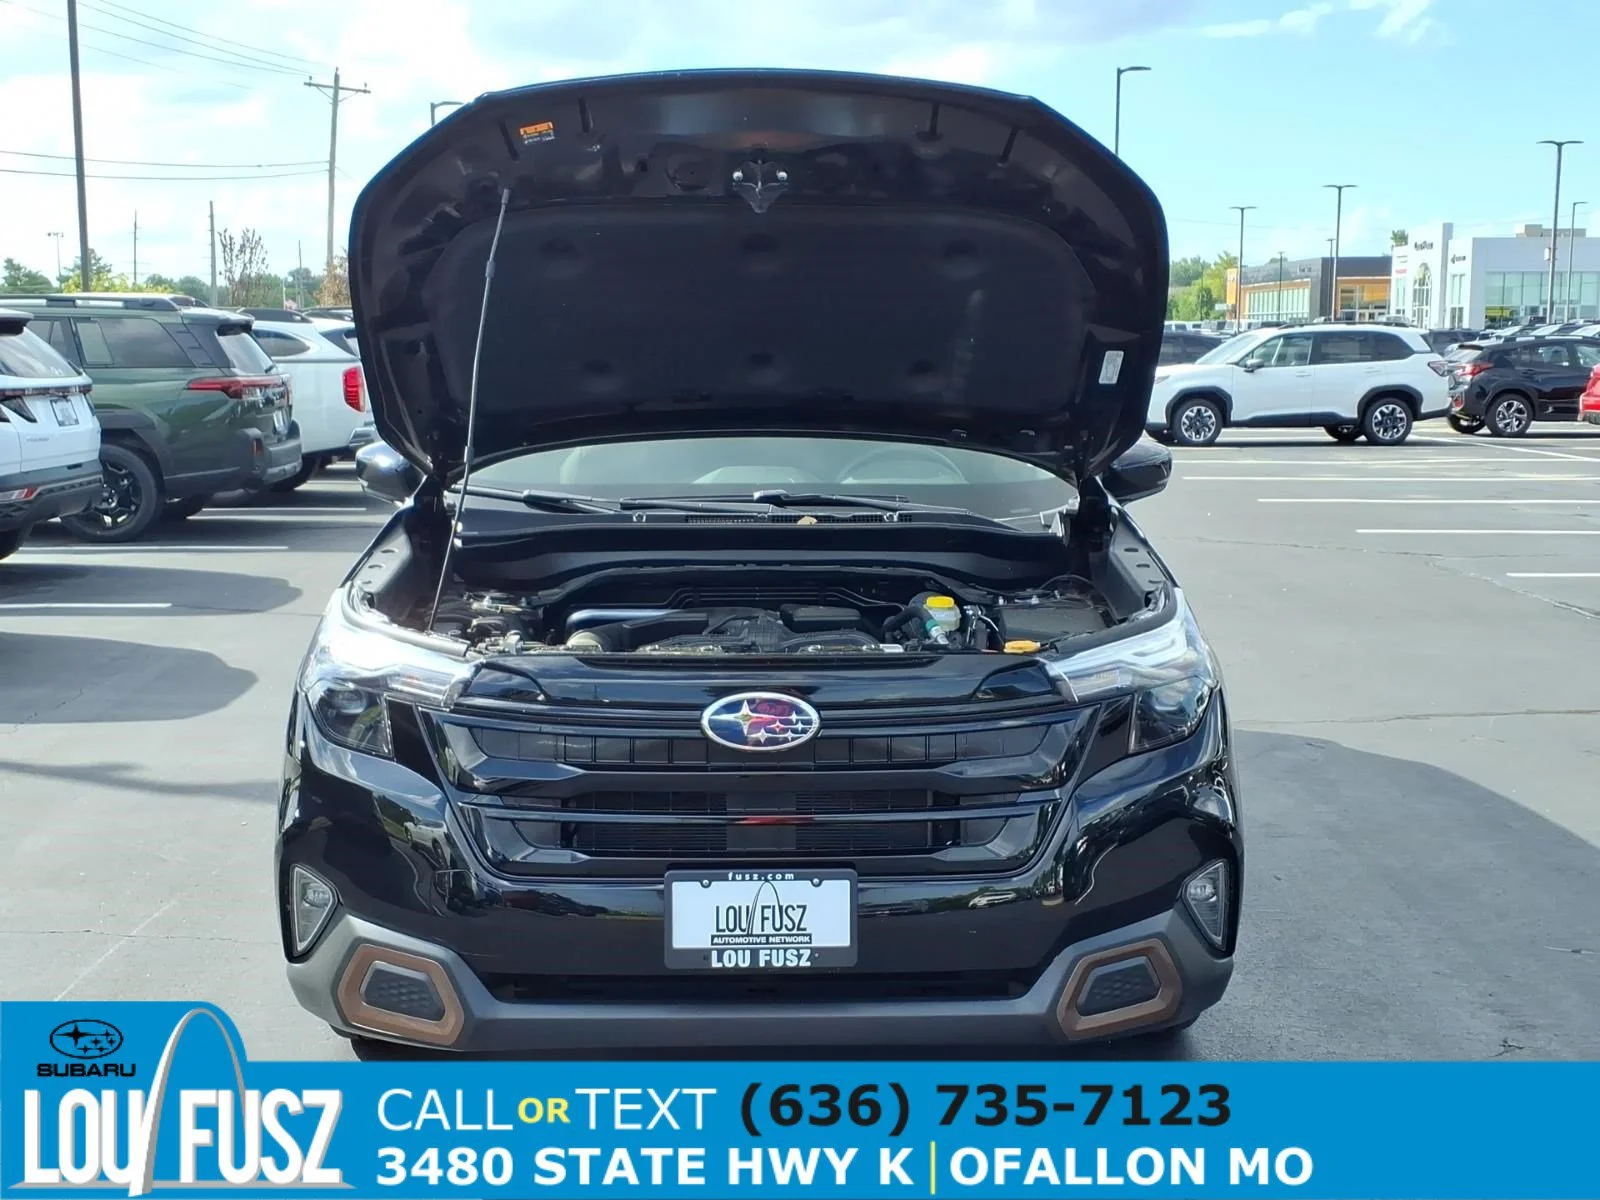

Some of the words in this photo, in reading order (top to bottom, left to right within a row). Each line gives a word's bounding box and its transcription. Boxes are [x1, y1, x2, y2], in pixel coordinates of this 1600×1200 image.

[728, 872, 794, 881] fusz.com
[715, 905, 750, 933] LOU
[760, 904, 808, 932] FUSZ
[712, 936, 767, 945] AUTOMOTIVE
[769, 936, 811, 944] NETWORK
[711, 950, 751, 968] LOU
[759, 949, 812, 967] FUSZ
